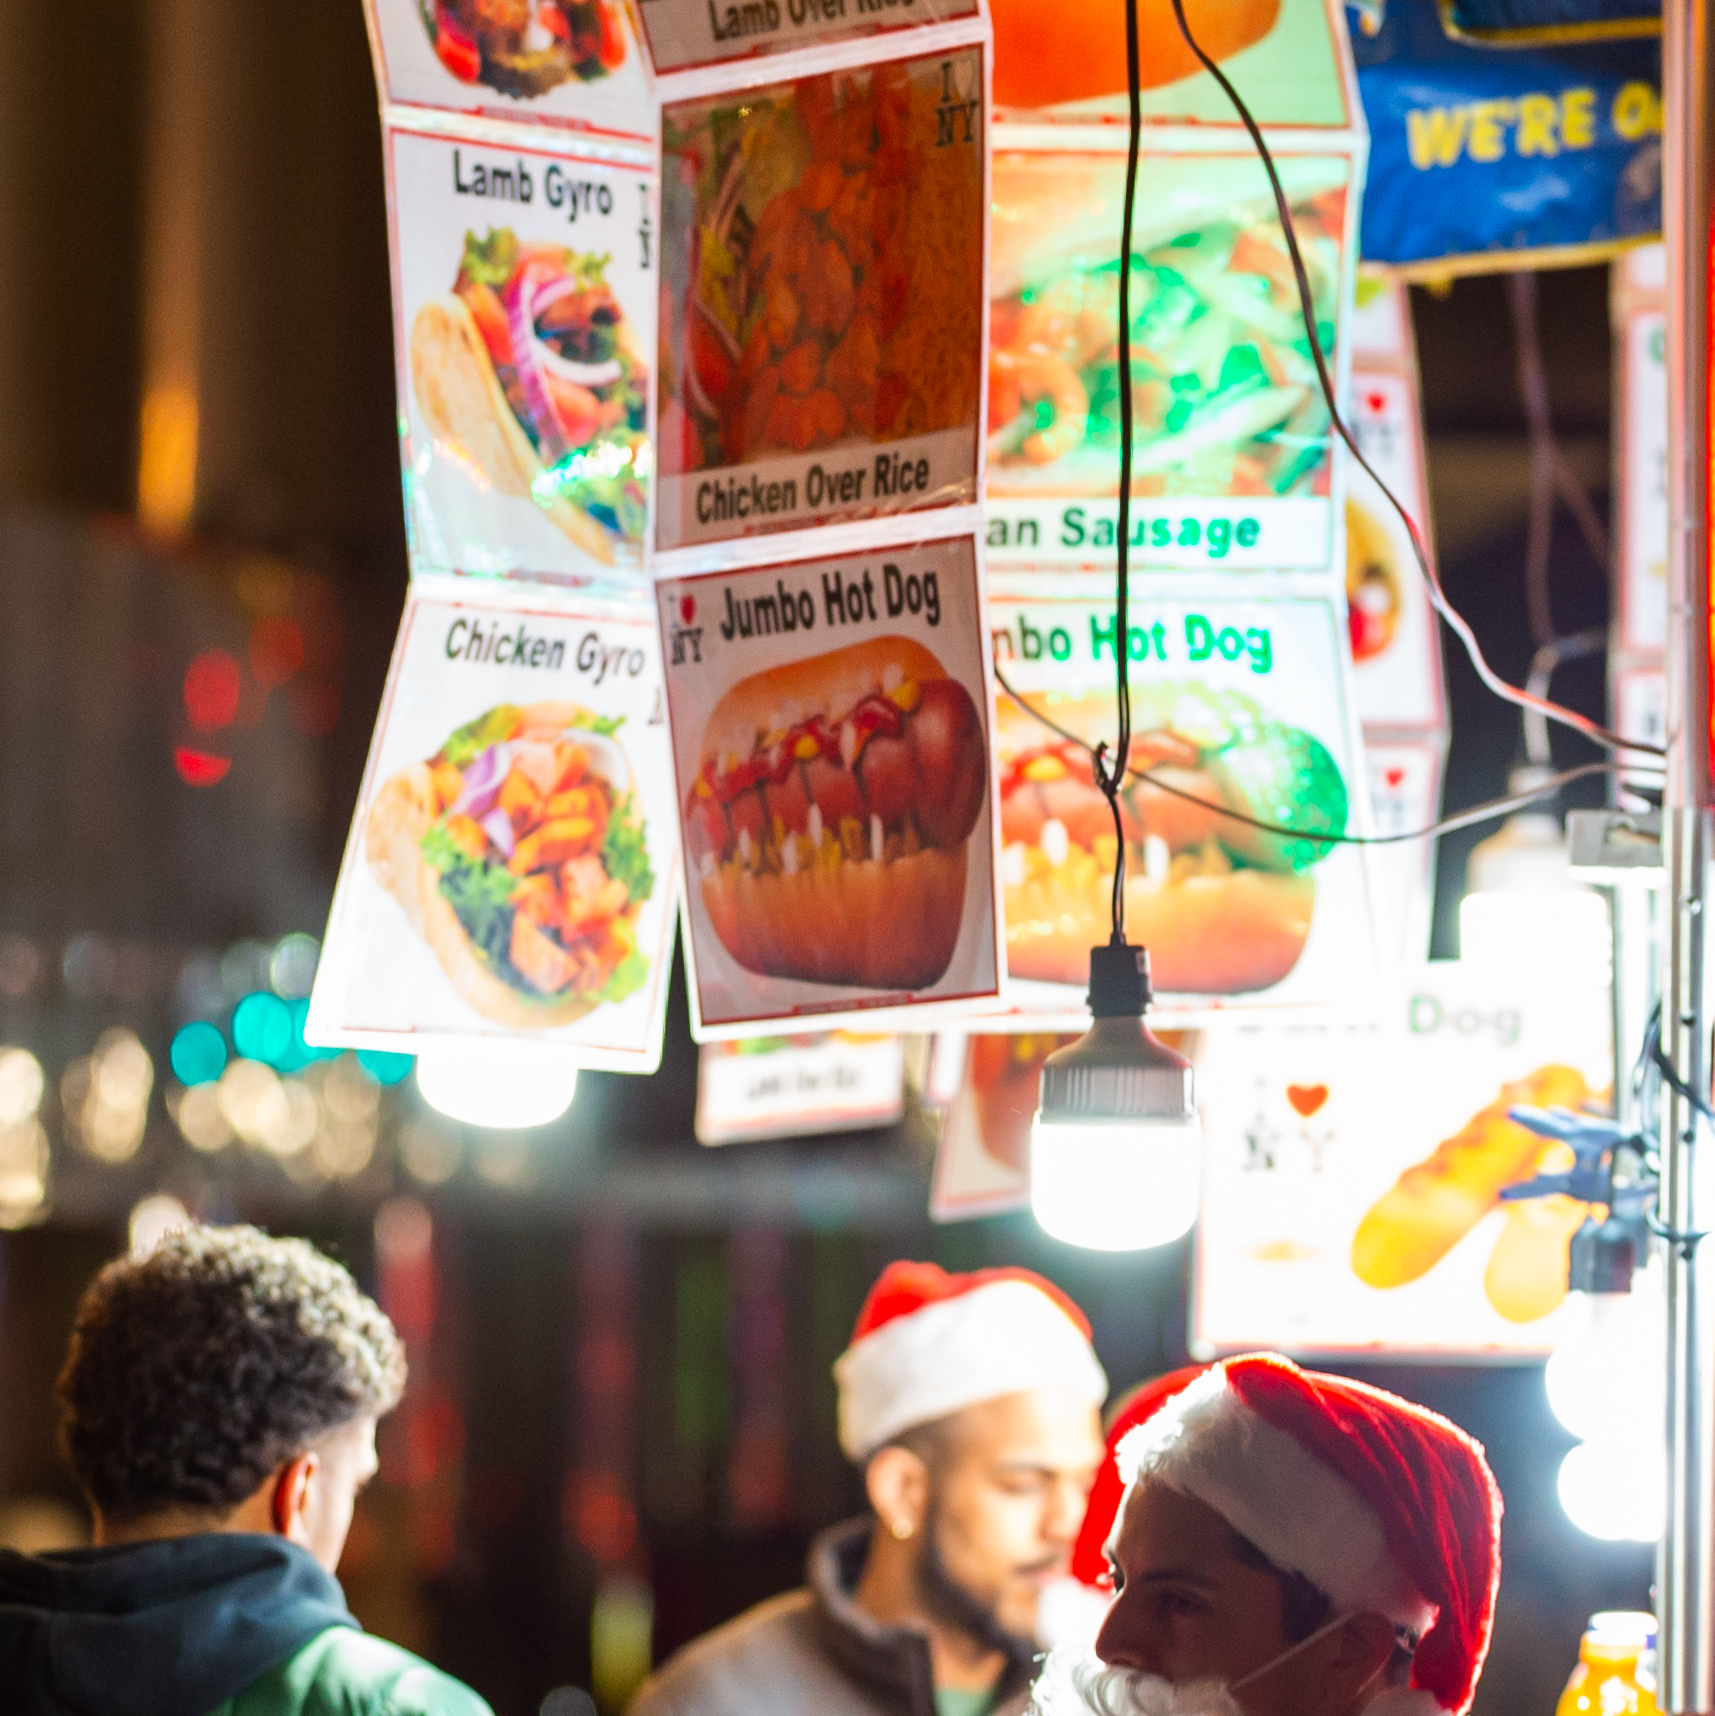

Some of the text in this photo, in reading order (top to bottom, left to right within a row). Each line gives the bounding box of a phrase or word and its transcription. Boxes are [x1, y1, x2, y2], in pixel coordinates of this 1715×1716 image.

[1407, 81, 1597, 171] WE'RE
[1612, 80, 1662, 142] O
[453, 149, 613, 222] Lamb Gyro
[697, 451, 930, 526] Chicken Over Rice
[986, 506, 1262, 558] an Sausage
[721, 563, 941, 642] Jumbo Hot Dog
[444, 618, 646, 687] Chicken Gyro
[1090, 615, 1167, 663] Hot
[1184, 613, 1274, 674] Dog
[1408, 993, 1521, 1046] Dog
